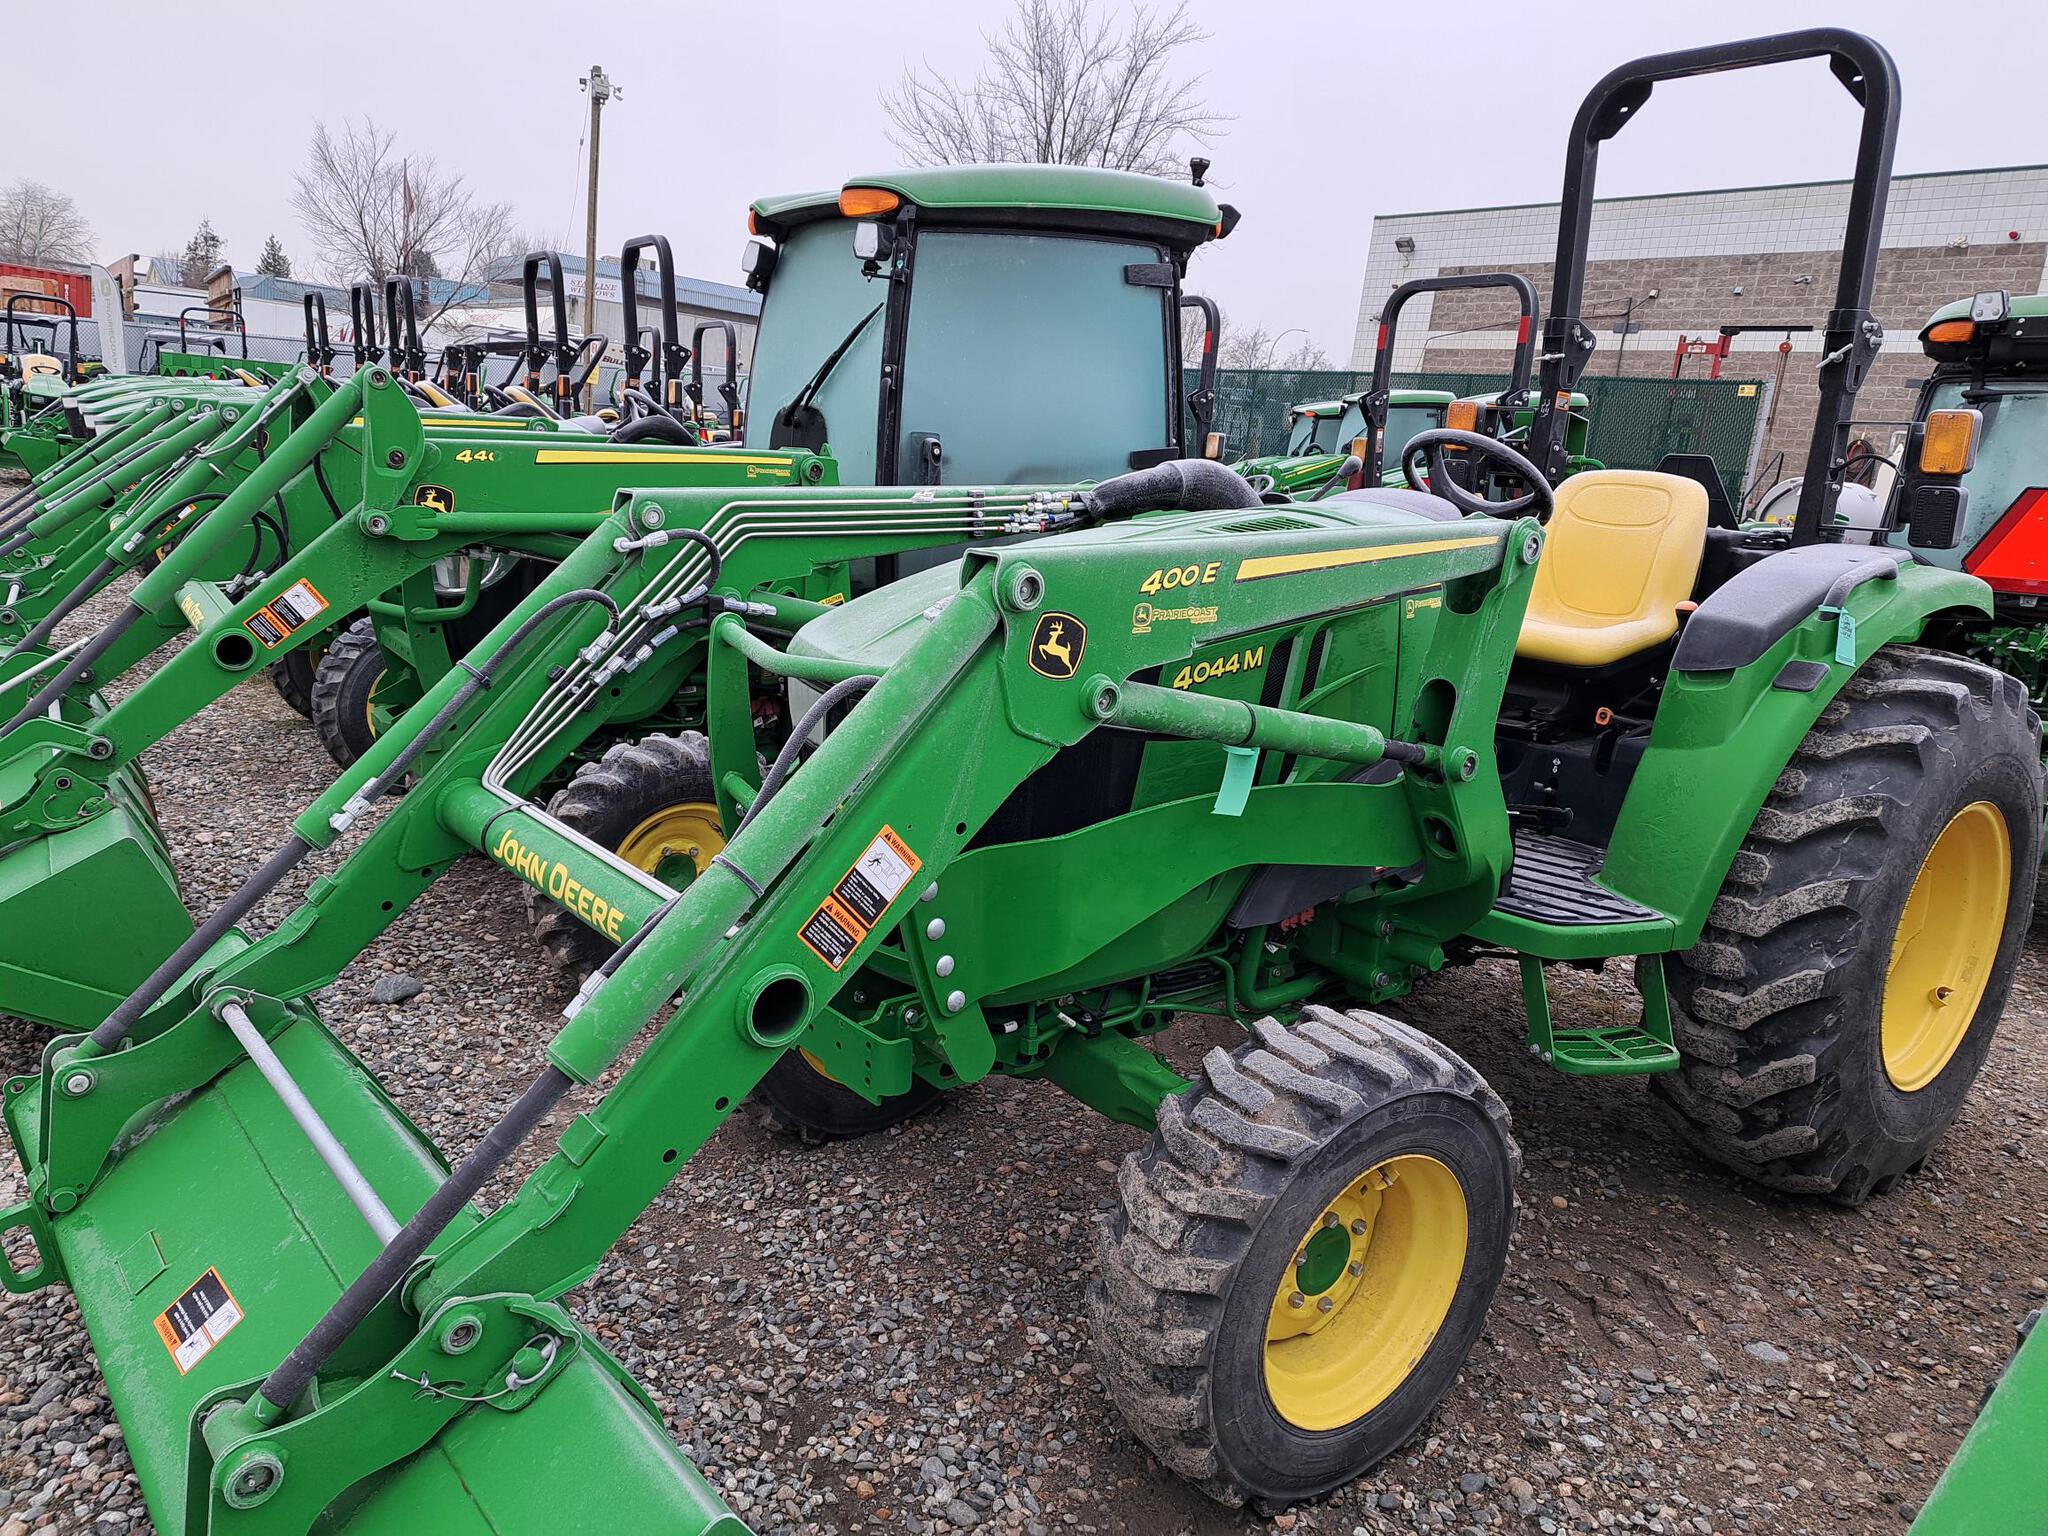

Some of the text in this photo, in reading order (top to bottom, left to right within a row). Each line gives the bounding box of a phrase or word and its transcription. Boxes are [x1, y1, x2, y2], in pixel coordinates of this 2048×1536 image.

[890, 837, 916, 867] WARNING
[493, 829, 625, 943] JOHN DEERE
[833, 909, 860, 937] WARNING
